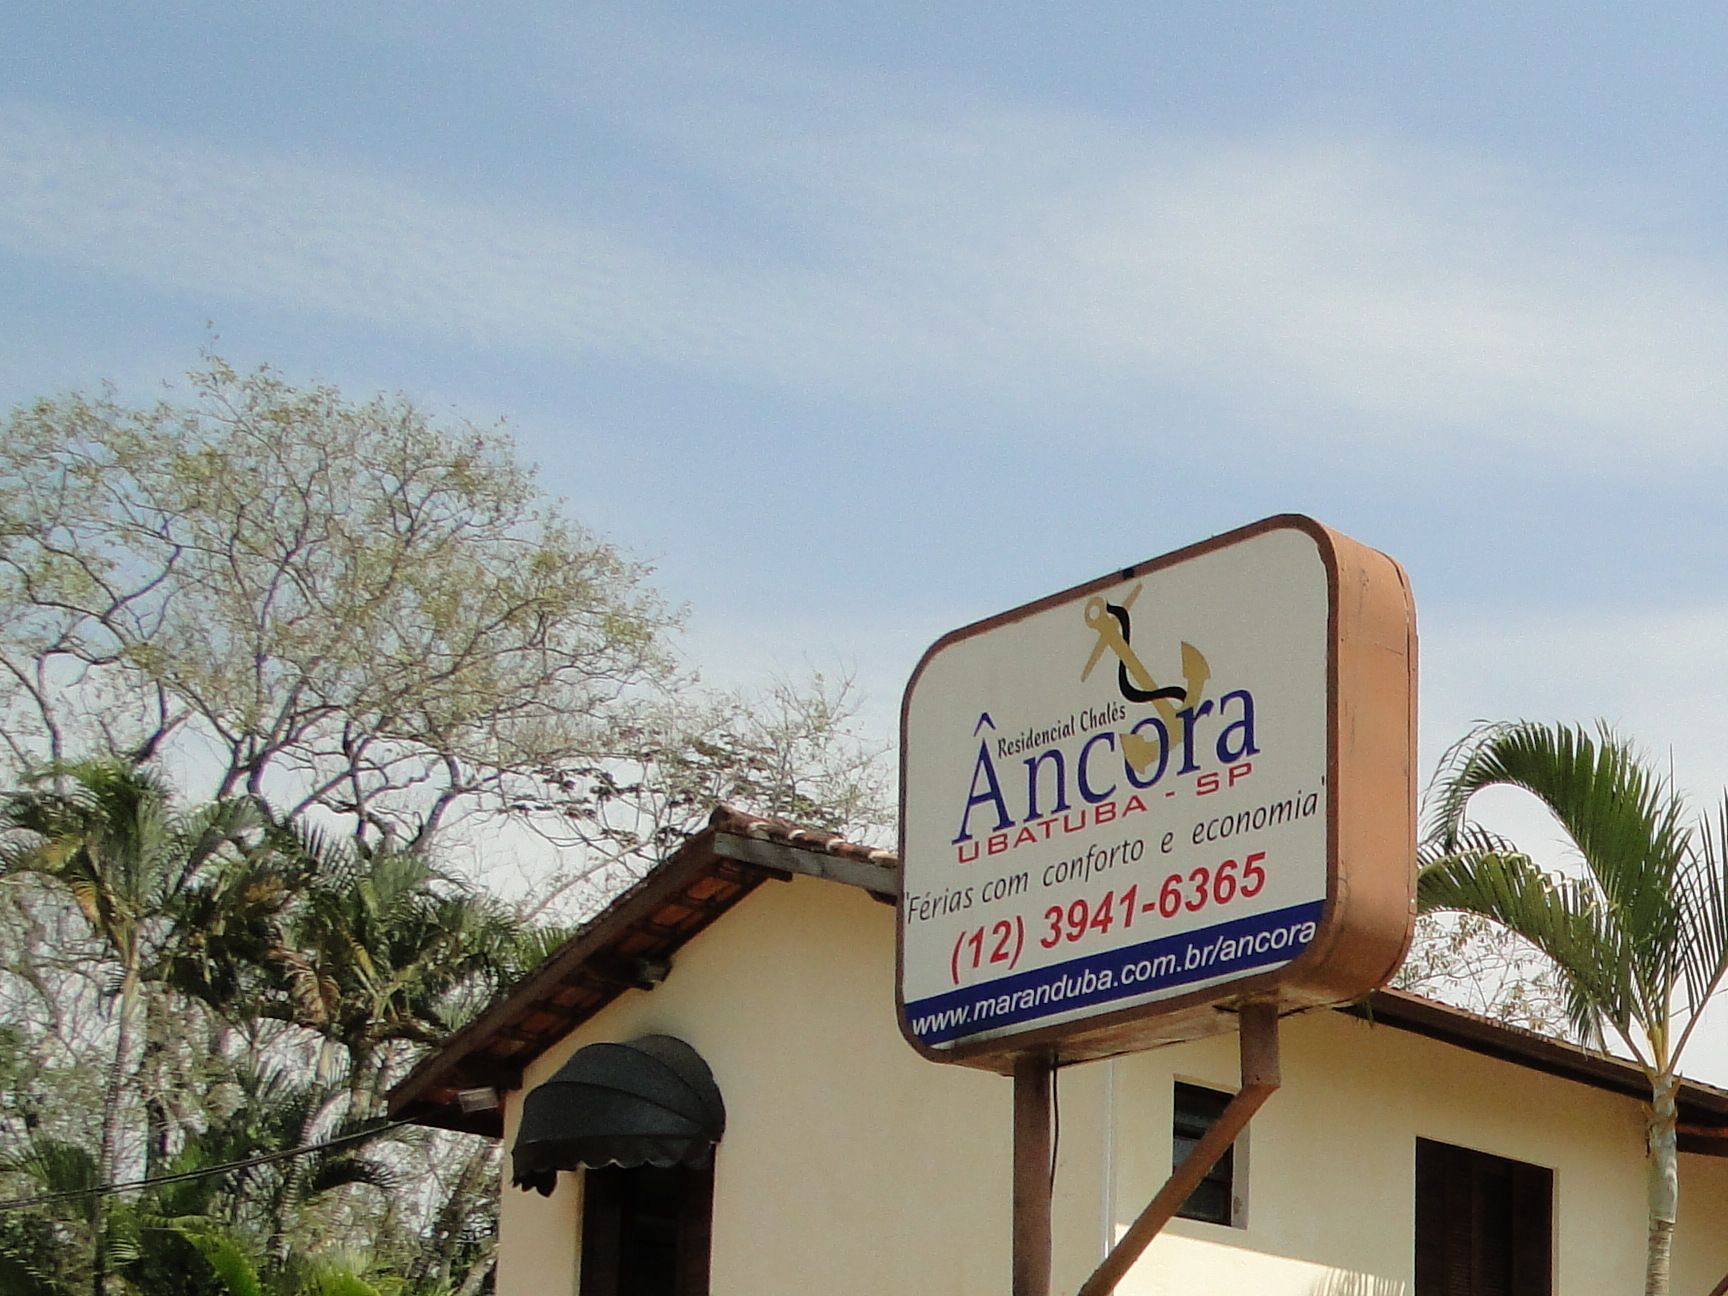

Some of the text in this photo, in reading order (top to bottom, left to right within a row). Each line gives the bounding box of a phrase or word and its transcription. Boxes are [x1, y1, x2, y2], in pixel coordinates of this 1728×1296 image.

[951, 688, 1261, 845] Âncora
[997, 702, 1127, 759] Residencial Chalés
[957, 795, 1147, 864] UBATUBA
[1196, 763, 1253, 796] SP
[982, 872, 1029, 904] com
[1042, 841, 1144, 892] conforto
[1160, 832, 1175, 854] e
[950, 852, 1267, 984] (12) 3941-6365
[912, 918, 1316, 1036] www.maranduba.com.br/ancora
